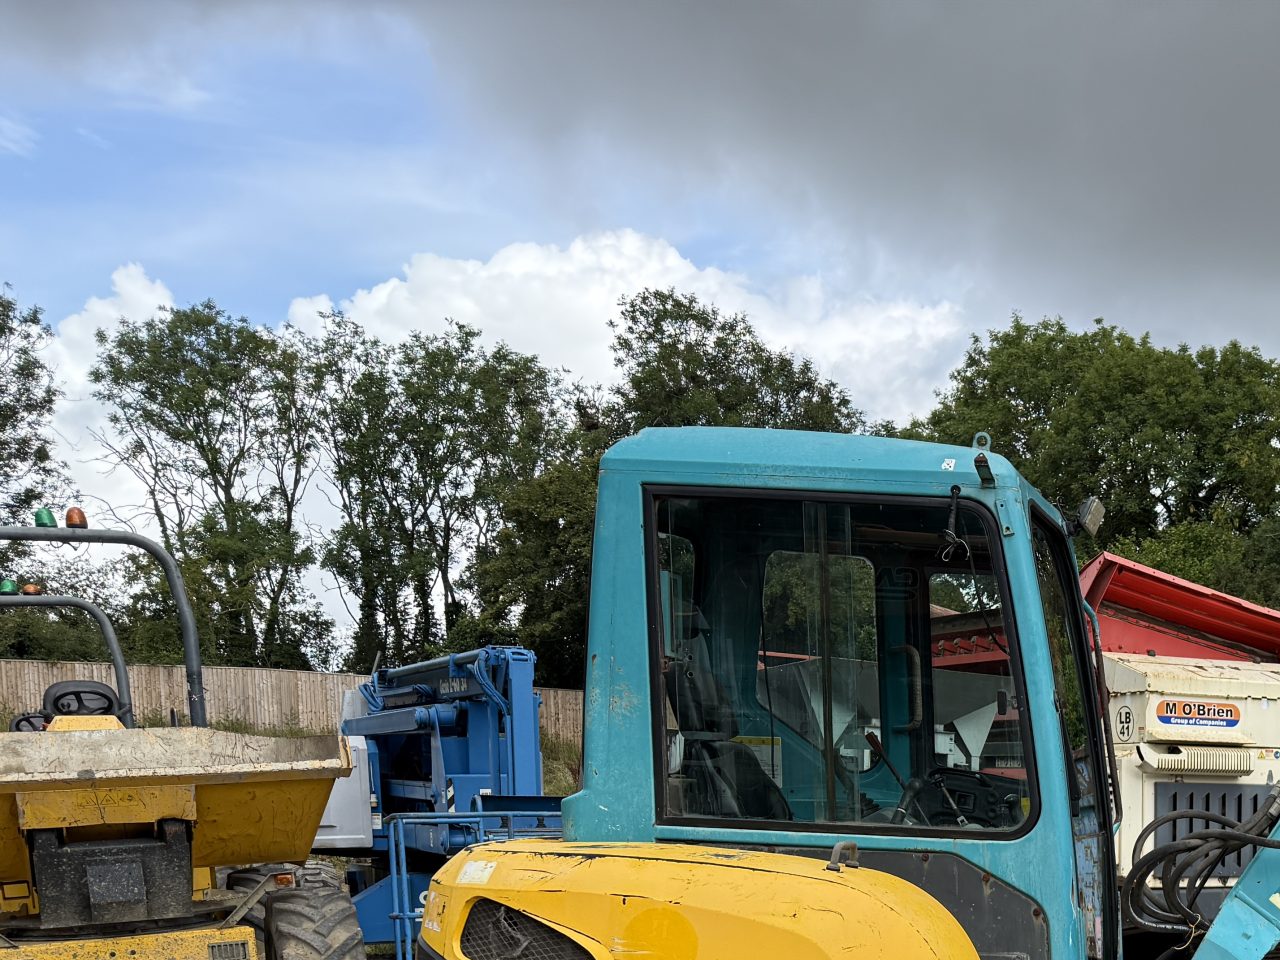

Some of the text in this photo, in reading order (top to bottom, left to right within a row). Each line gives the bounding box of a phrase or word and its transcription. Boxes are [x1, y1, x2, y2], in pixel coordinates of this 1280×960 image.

[1165, 703, 1177, 715] M
[1119, 712, 1131, 724] LB
[1170, 717, 1188, 725] Group
[1196, 718, 1227, 726] Companies
[1119, 725, 1130, 737] 41
